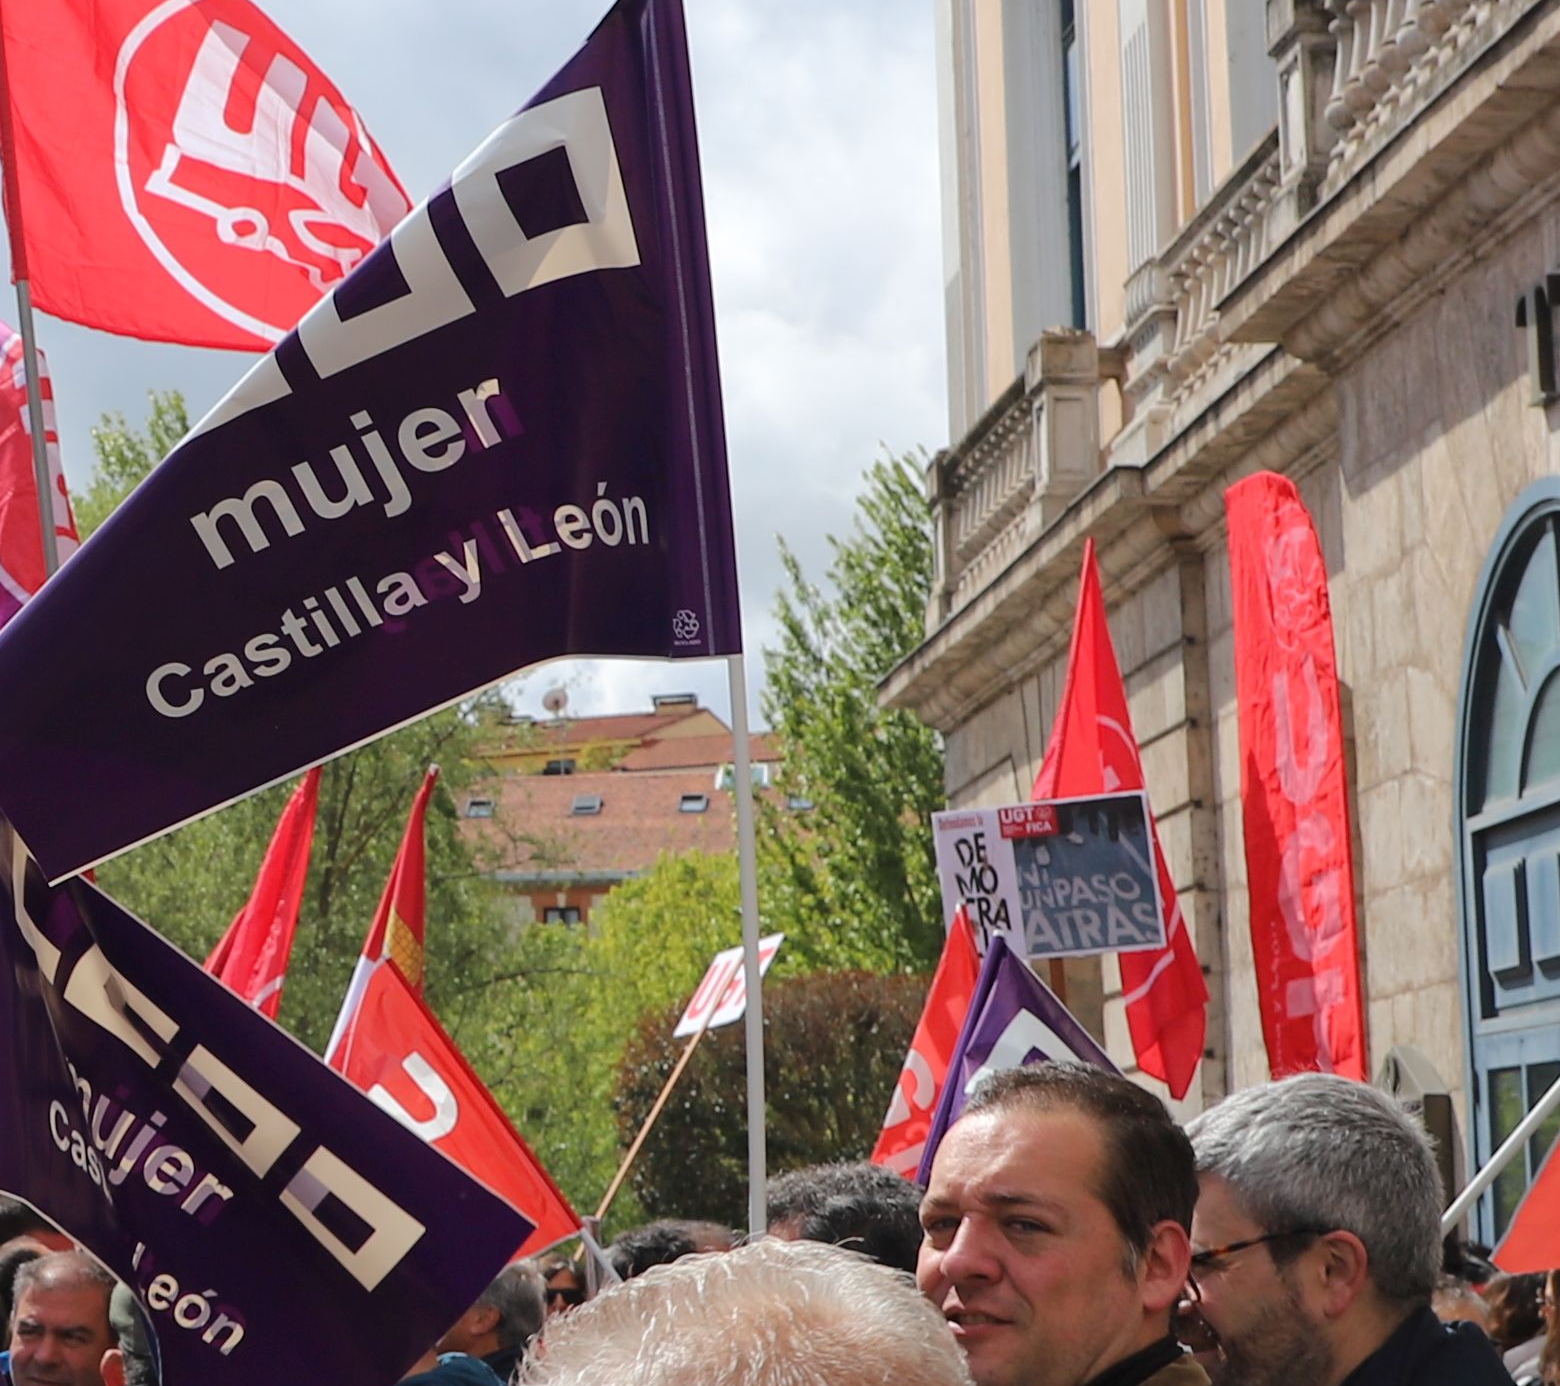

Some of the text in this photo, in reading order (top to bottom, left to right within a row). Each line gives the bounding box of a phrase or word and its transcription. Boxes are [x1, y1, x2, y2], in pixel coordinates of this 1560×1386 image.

[190, 374, 503, 570] mujer
[146, 480, 650, 719] Castilla y León
[1000, 806, 1034, 825] UGT
[953, 833, 986, 868] DE
[953, 865, 999, 903] MO
[1053, 871, 1142, 908] PASO
